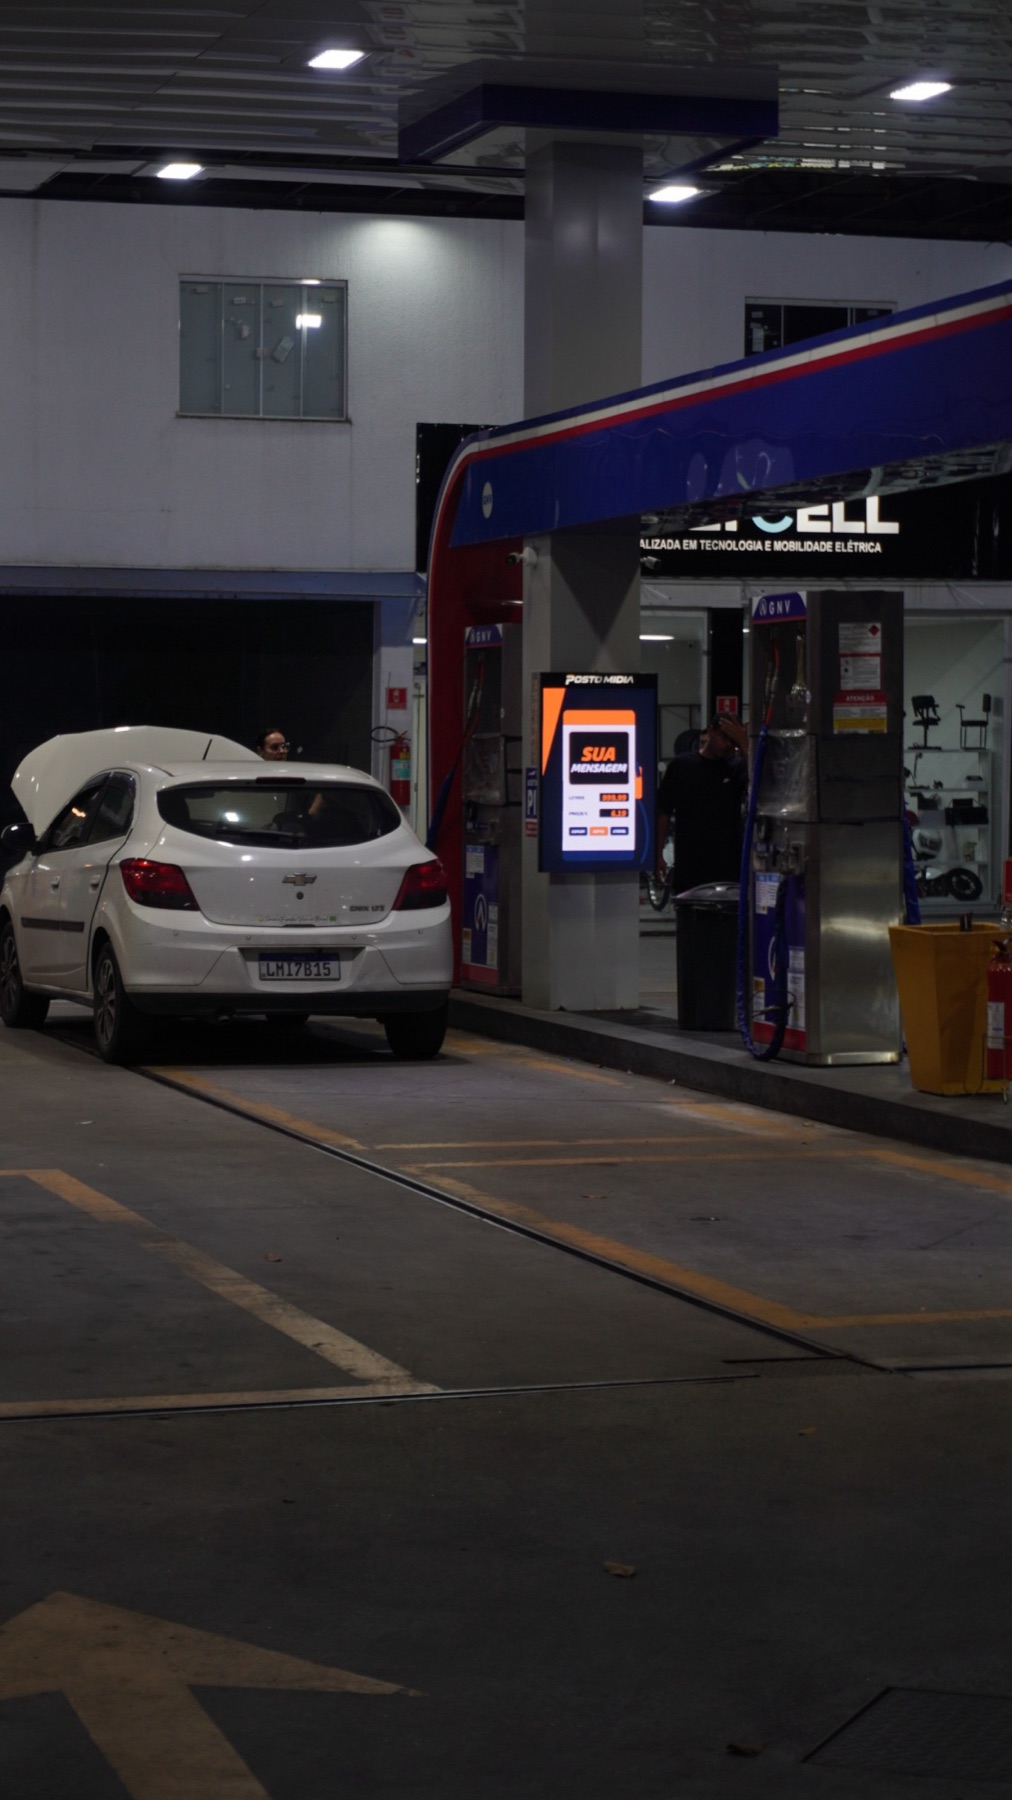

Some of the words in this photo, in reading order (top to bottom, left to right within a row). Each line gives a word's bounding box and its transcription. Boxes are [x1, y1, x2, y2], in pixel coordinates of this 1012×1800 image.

[683, 539, 697, 550] EM
[700, 540, 763, 551] TECNOLOGIA
[764, 541, 772, 551] E
[774, 541, 833, 552] MOBILIDADE
[835, 539, 882, 553] ELÉTRICA
[769, 600, 790, 615] GNV
[565, 675, 602, 685] POSTO
[581, 746, 616, 762] SUA
[570, 763, 628, 773] MENSAGEM
[266, 962, 331, 977] LMI7B15
